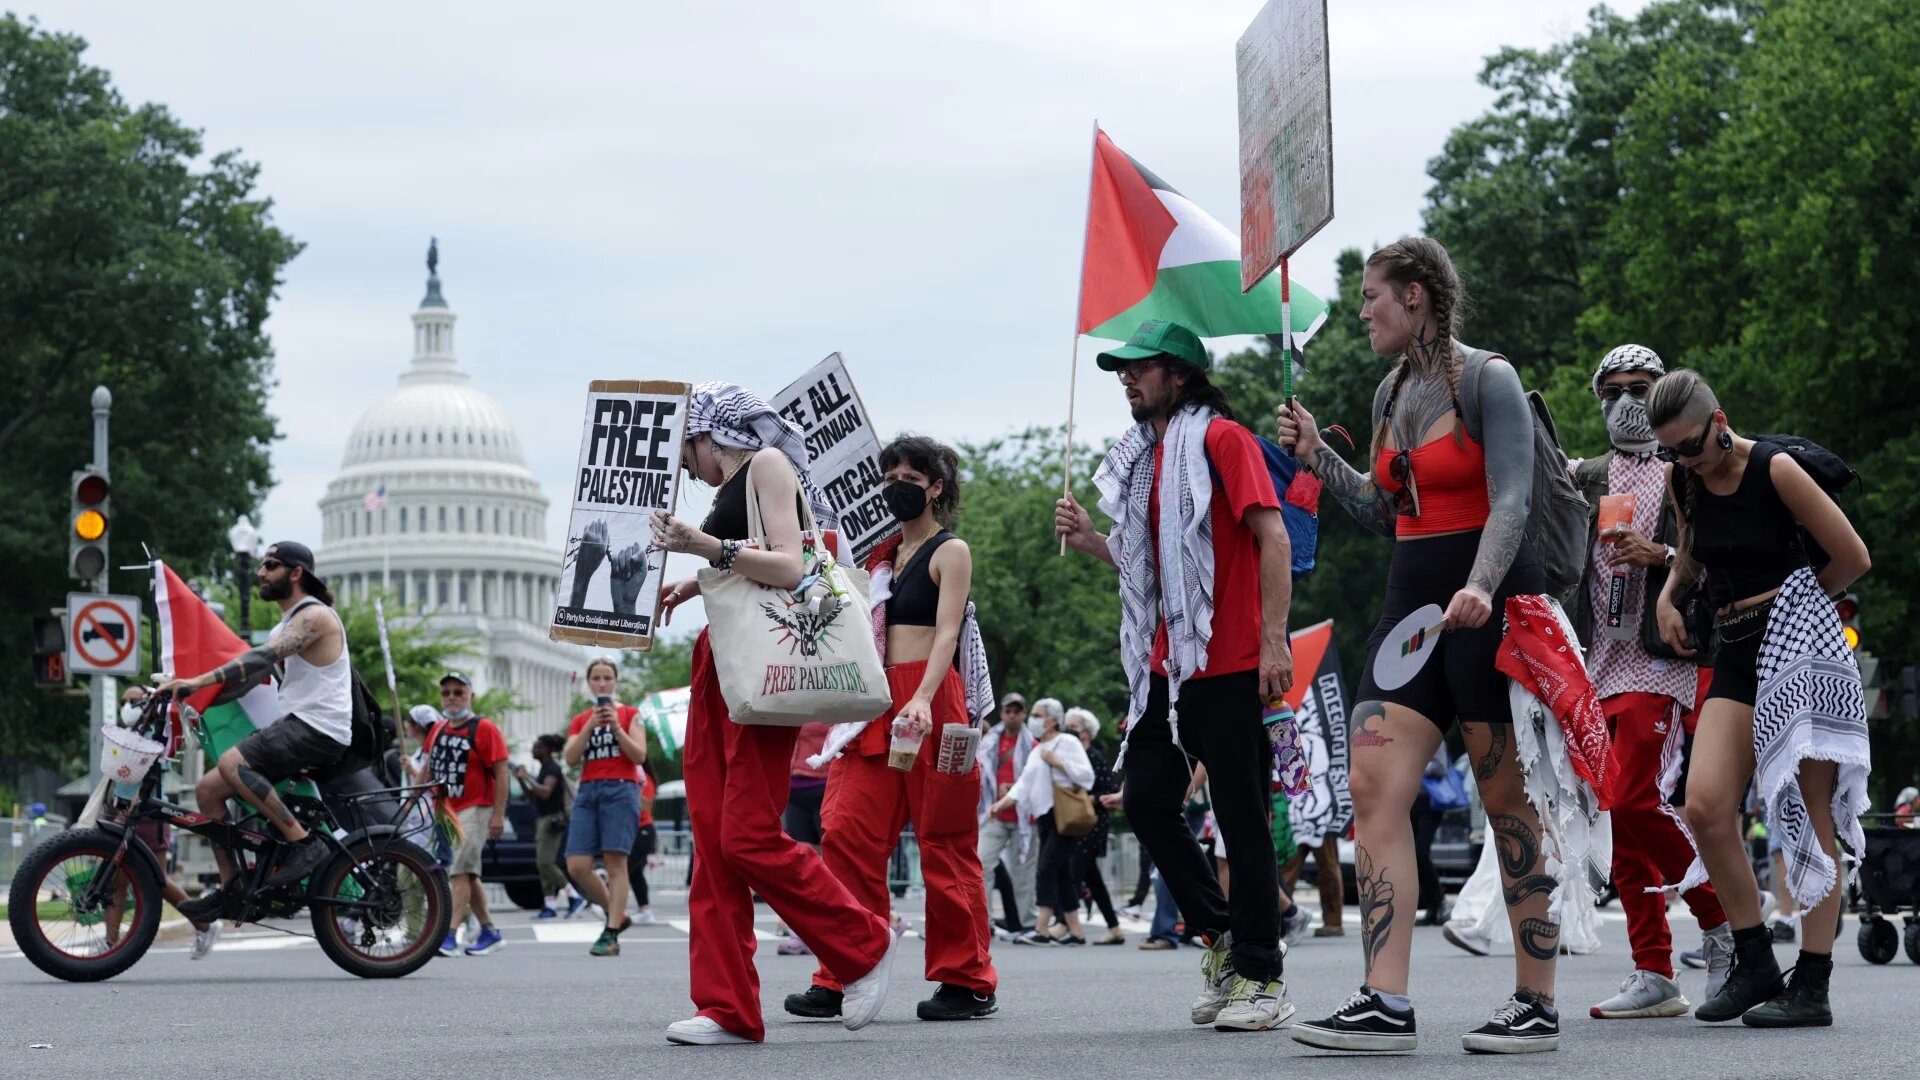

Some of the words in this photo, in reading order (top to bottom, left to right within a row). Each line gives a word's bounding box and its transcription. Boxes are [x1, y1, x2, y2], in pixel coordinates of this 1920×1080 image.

[807, 373, 851, 423] ALL
[588, 399, 676, 471] FREE
[804, 404, 862, 464] STINIAN
[578, 468, 672, 509] PALESTINE
[823, 455, 885, 514] ITICAL
[853, 543, 872, 559] ocialism
[872, 535, 882, 547] and
[1610, 577, 1622, 614] essentia
[566, 613, 579, 624] Party
[578, 614, 586, 623] for
[585, 615, 609, 625] Socialism
[609, 619, 620, 627] and
[620, 619, 647, 630] Liberation
[761, 664, 796, 696] FREE
[799, 661, 868, 696] PALESTINE
[1318, 672, 1346, 726] FREE
[440, 734, 471, 751] EWS
[587, 745, 621, 761] AME
[942, 733, 953, 758] THE
